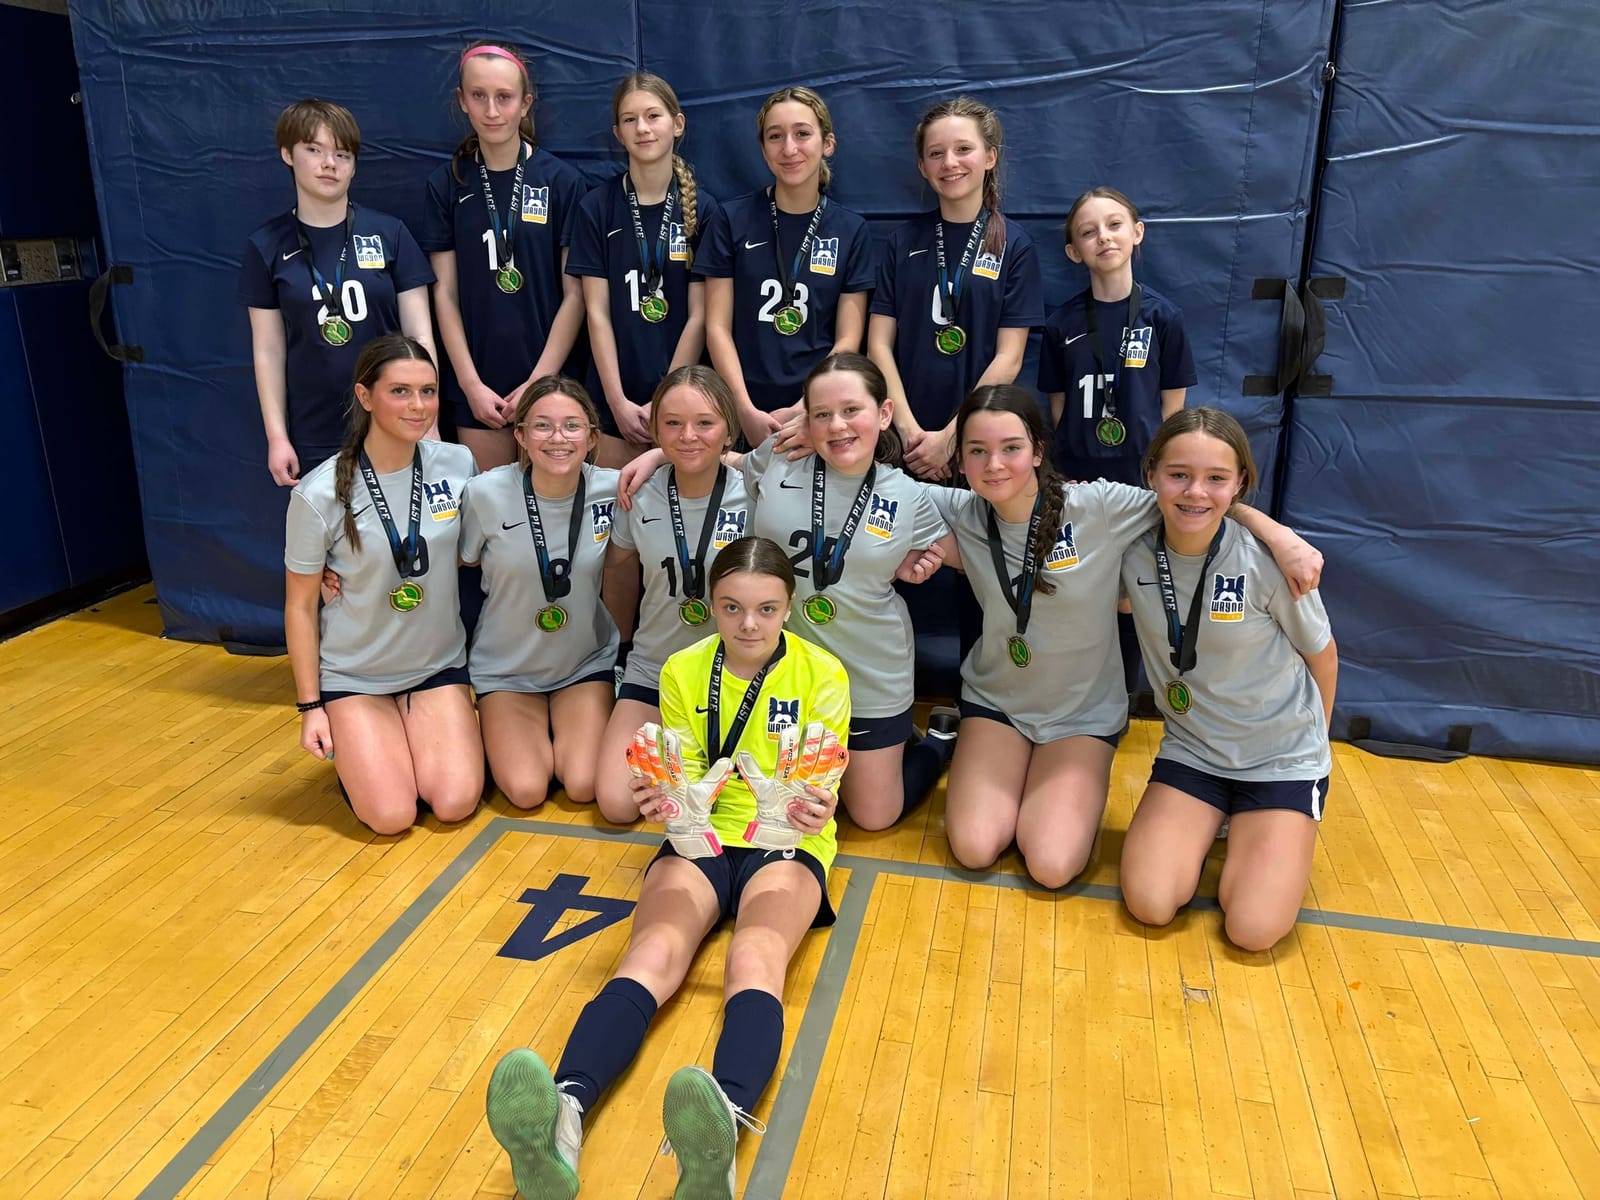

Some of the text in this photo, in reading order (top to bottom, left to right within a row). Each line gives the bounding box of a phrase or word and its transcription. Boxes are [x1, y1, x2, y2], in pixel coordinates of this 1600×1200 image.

[670, 244, 688, 253] WAY
[757, 278, 809, 324] 23
[1126, 349, 1148, 360] AYNE
[363, 468, 391, 521] 1ST PLACE
[410, 468, 423, 522] 1ST PLACE
[526, 495, 545, 547] 1ST PLACE
[668, 485, 684, 537] 1ST PLACE
[814, 470, 824, 526] 1ST PLACE
[843, 483, 872, 538] 1ST PLACE
[1157, 551, 1176, 611] 1ST PLACE
[710, 653, 723, 712] 1ST PLACE
[737, 701, 748, 722] 1ST
[495, 873, 638, 962] 4
